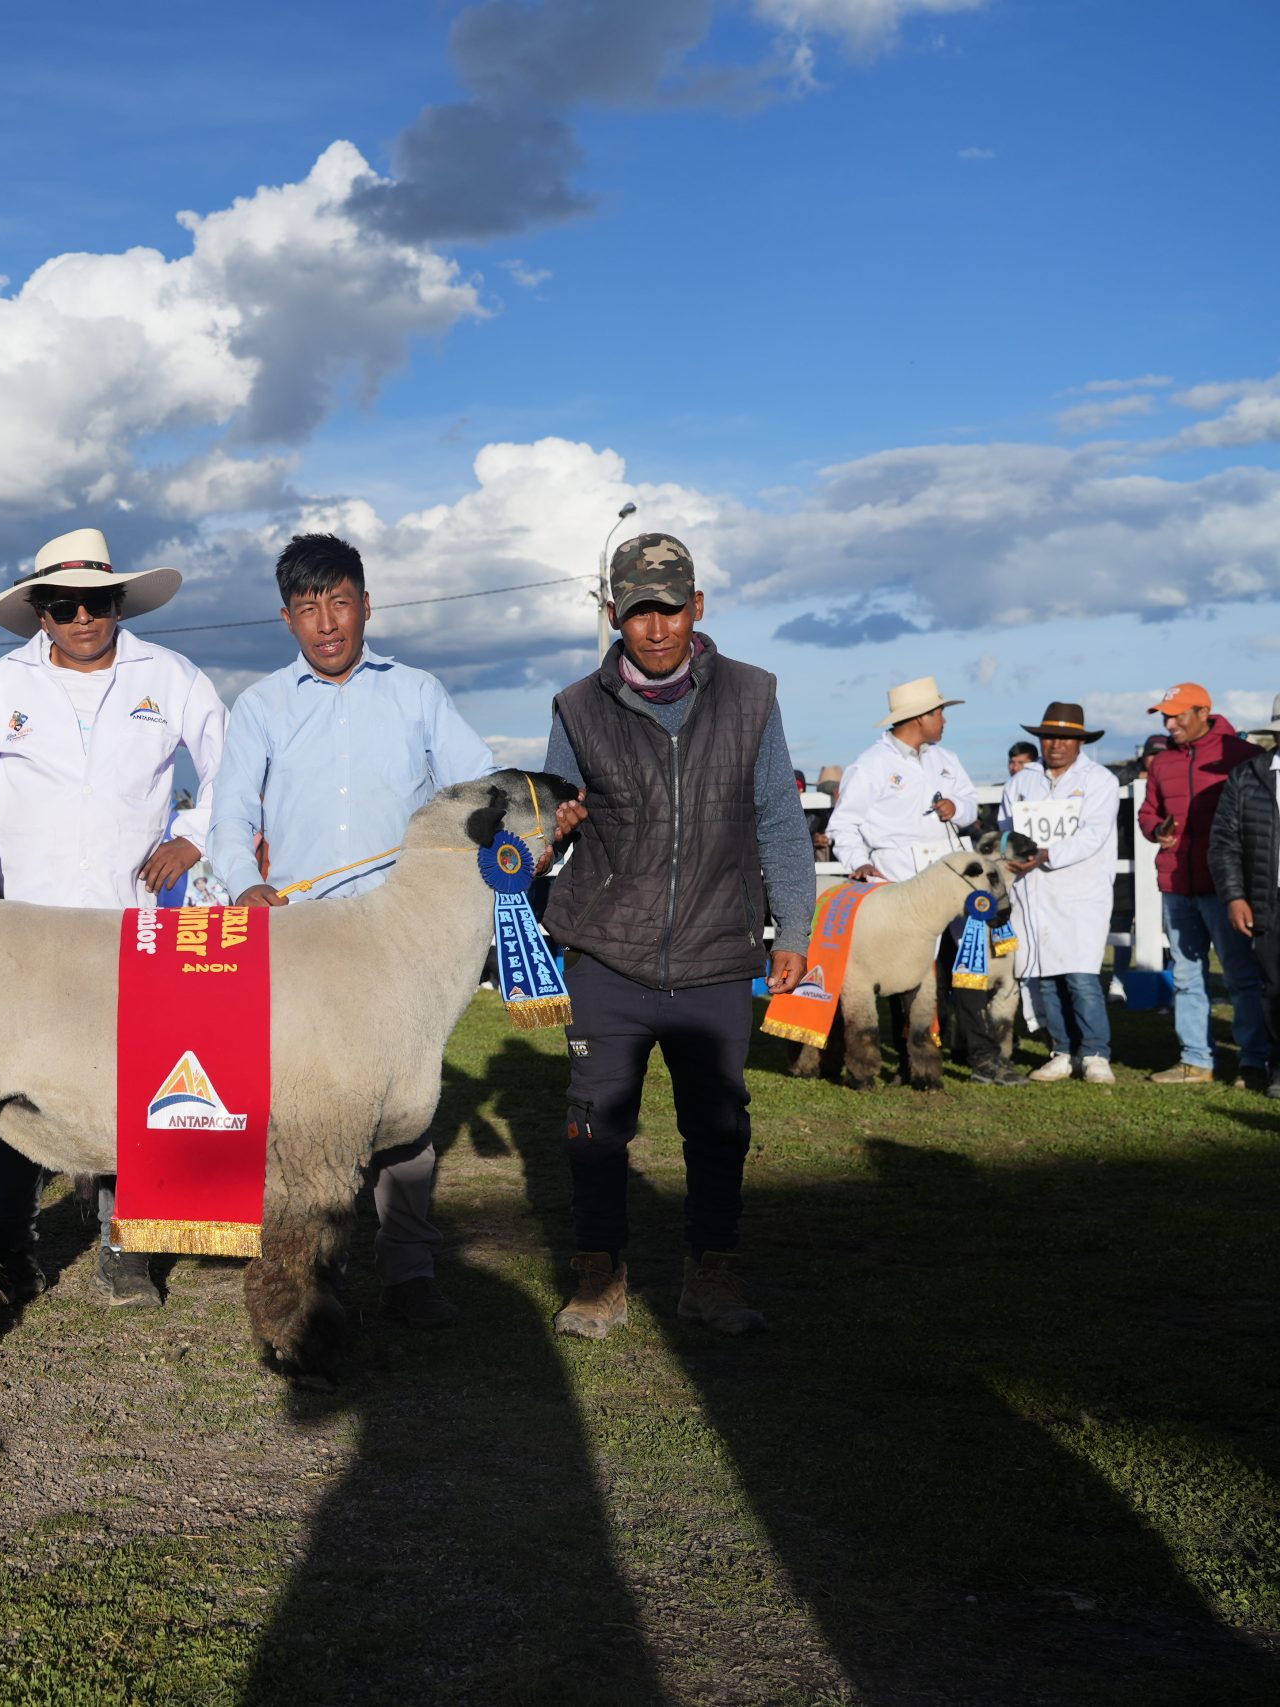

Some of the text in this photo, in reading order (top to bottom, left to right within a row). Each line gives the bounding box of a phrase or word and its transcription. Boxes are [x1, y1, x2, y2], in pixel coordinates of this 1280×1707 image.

[1024, 816, 1080, 842] 1942
[499, 893, 522, 905] EXPO
[170, 906, 220, 957] pinar
[498, 910, 524, 983] REYES
[519, 909, 553, 985] ESPINAR
[182, 963, 238, 973] 2024
[538, 985, 559, 994] 2024
[168, 1115, 246, 1129] ANTAPACCAY
